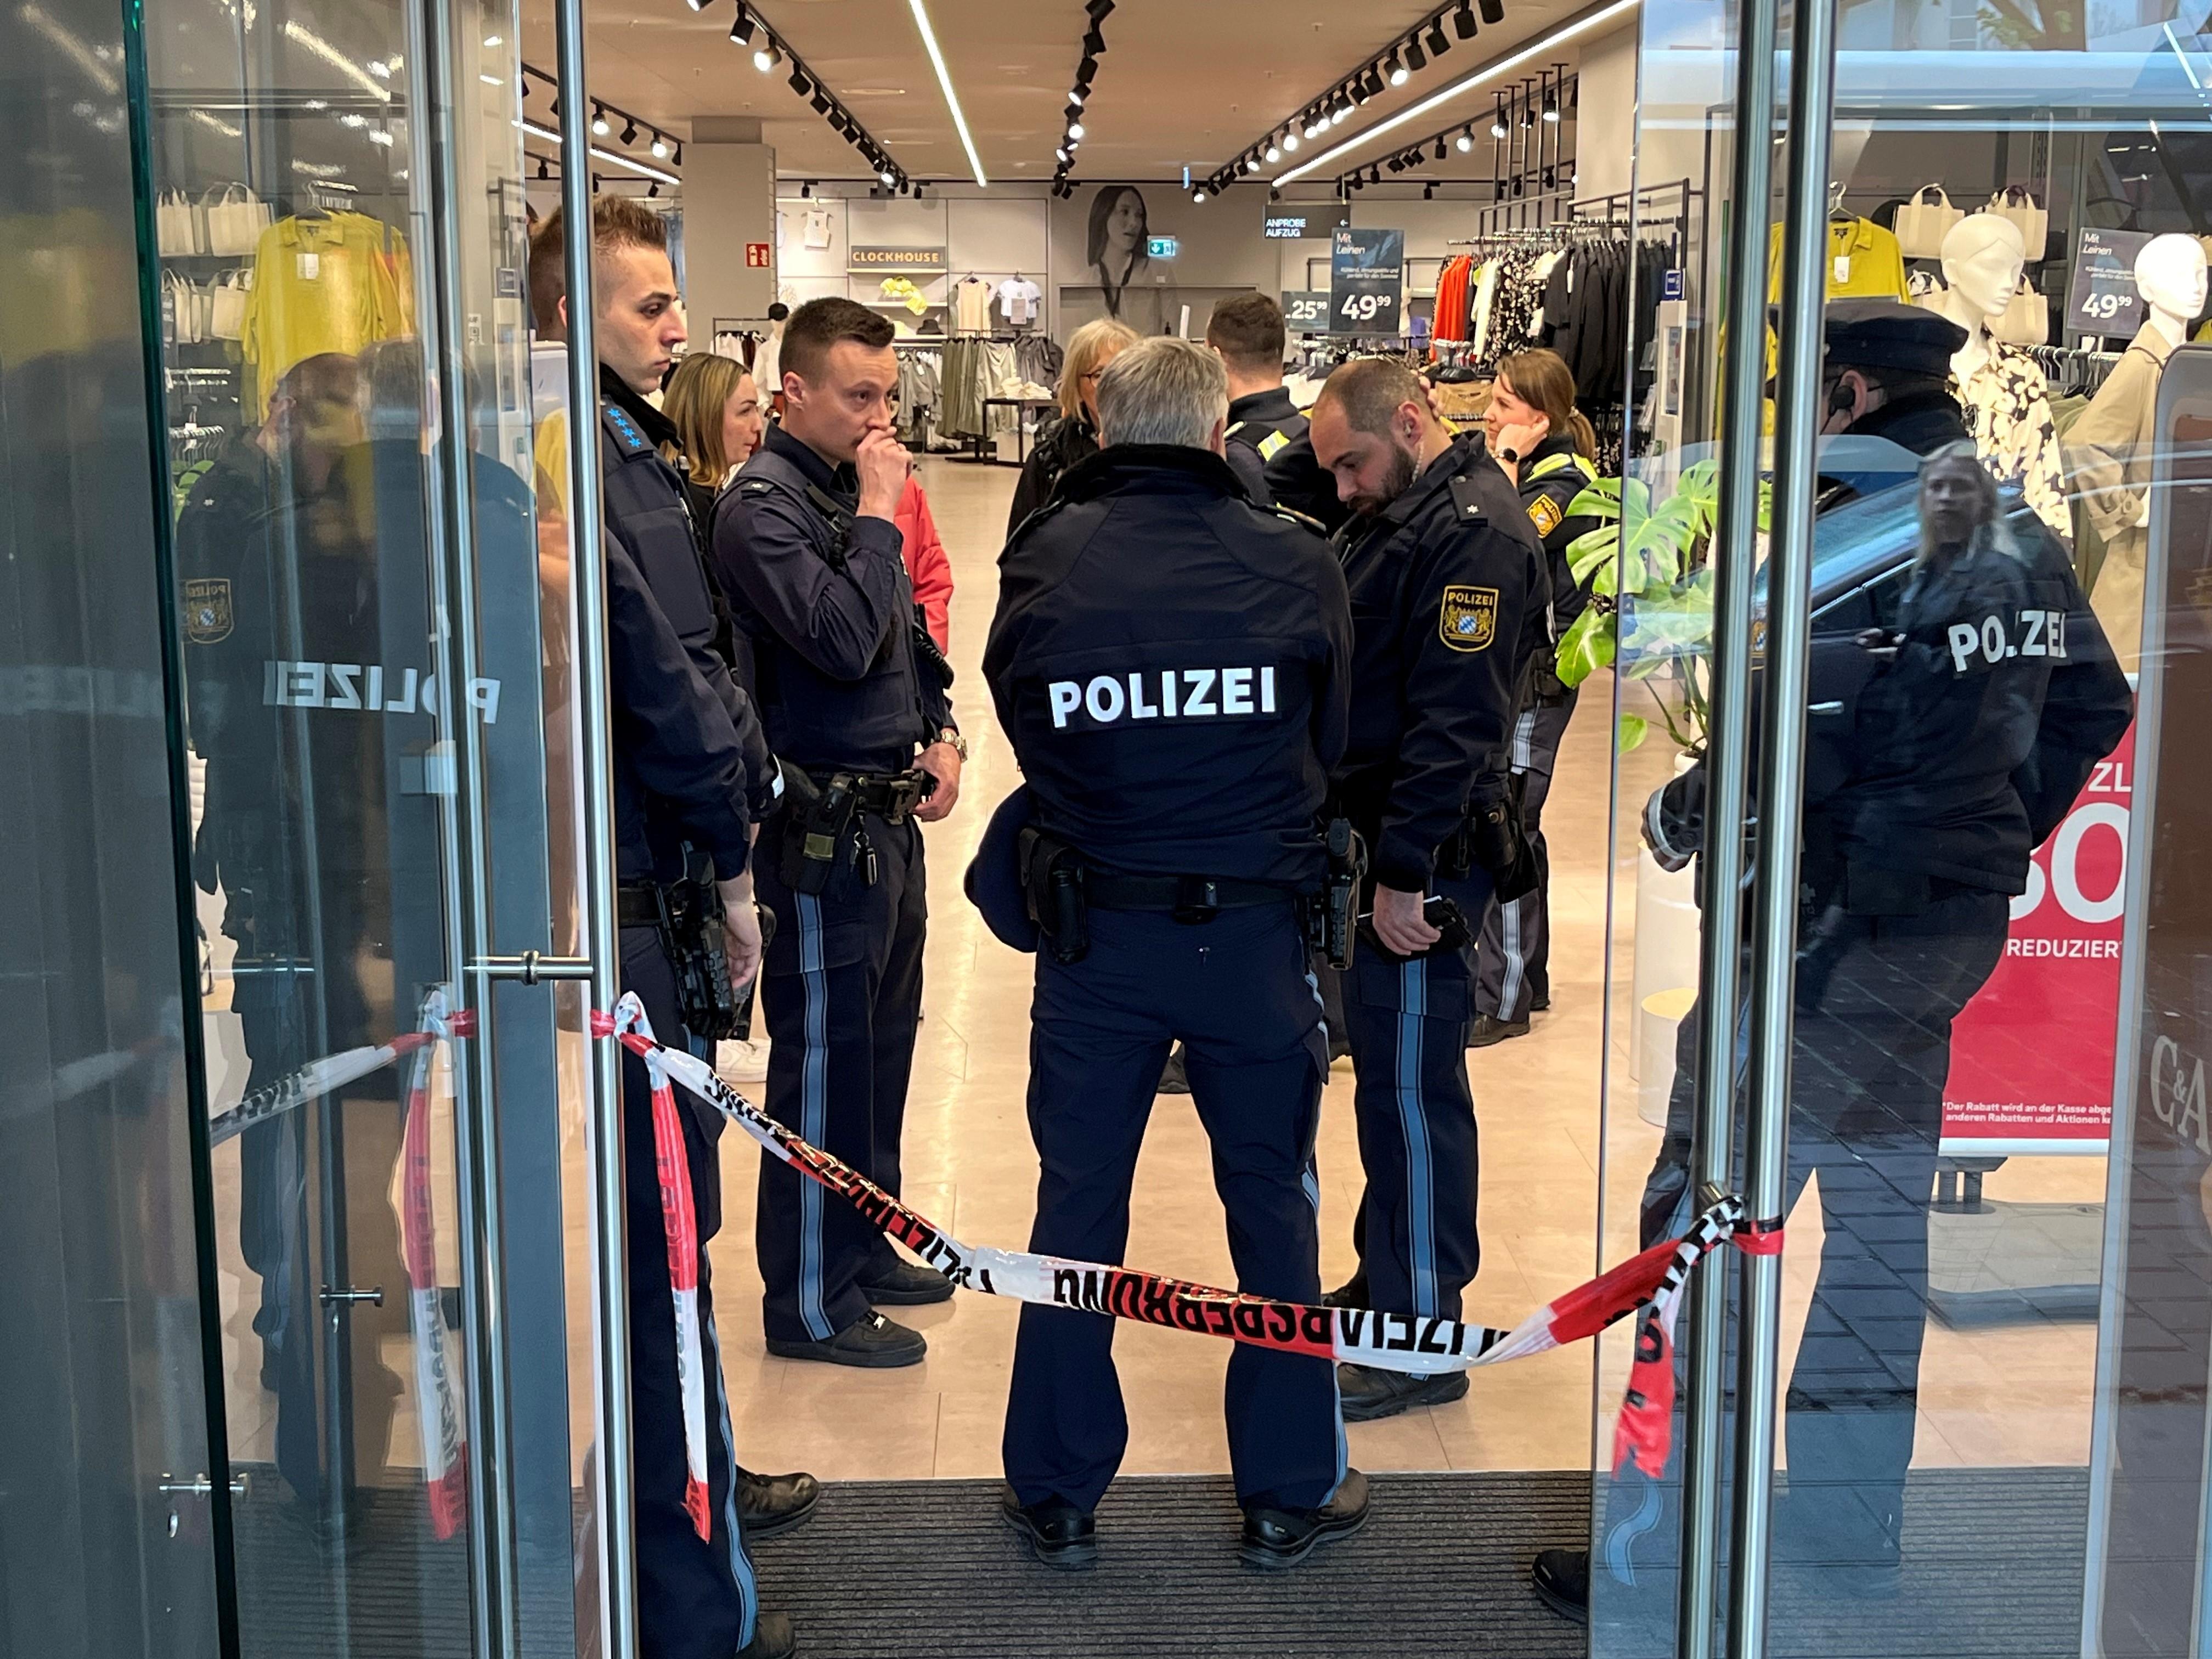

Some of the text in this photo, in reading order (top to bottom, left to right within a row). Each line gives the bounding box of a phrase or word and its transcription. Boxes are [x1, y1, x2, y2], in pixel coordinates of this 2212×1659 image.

[1266, 219, 1306, 228] ANPROBE
[1266, 228, 1301, 237] AUFZUG
[1336, 232, 1352, 243] Mit
[2085, 233, 2100, 243] Mit
[1336, 245, 1365, 255] Leinen
[2083, 245, 2112, 255] Leinen
[853, 251, 939, 263] CLOCKHOUSE
[1448, 592, 1493, 606] POLIZEI
[1048, 667, 1276, 728] POLIZEI
[2006, 939, 2122, 958] REDUZIER
[2150, 1035, 2211, 1155] C&A
[1966, 1102, 1999, 1111] Rabatt
[2002, 1102, 2023, 1112] wird
[2039, 1103, 2056, 1113] der
[2058, 1103, 2086, 1113] Kasse
[1946, 1112, 1986, 1121] anderen
[1988, 1113, 2033, 1122] Rabatten
[2035, 1114, 2054, 1123] und
[2056, 1114, 2100, 1124] Aktionen
